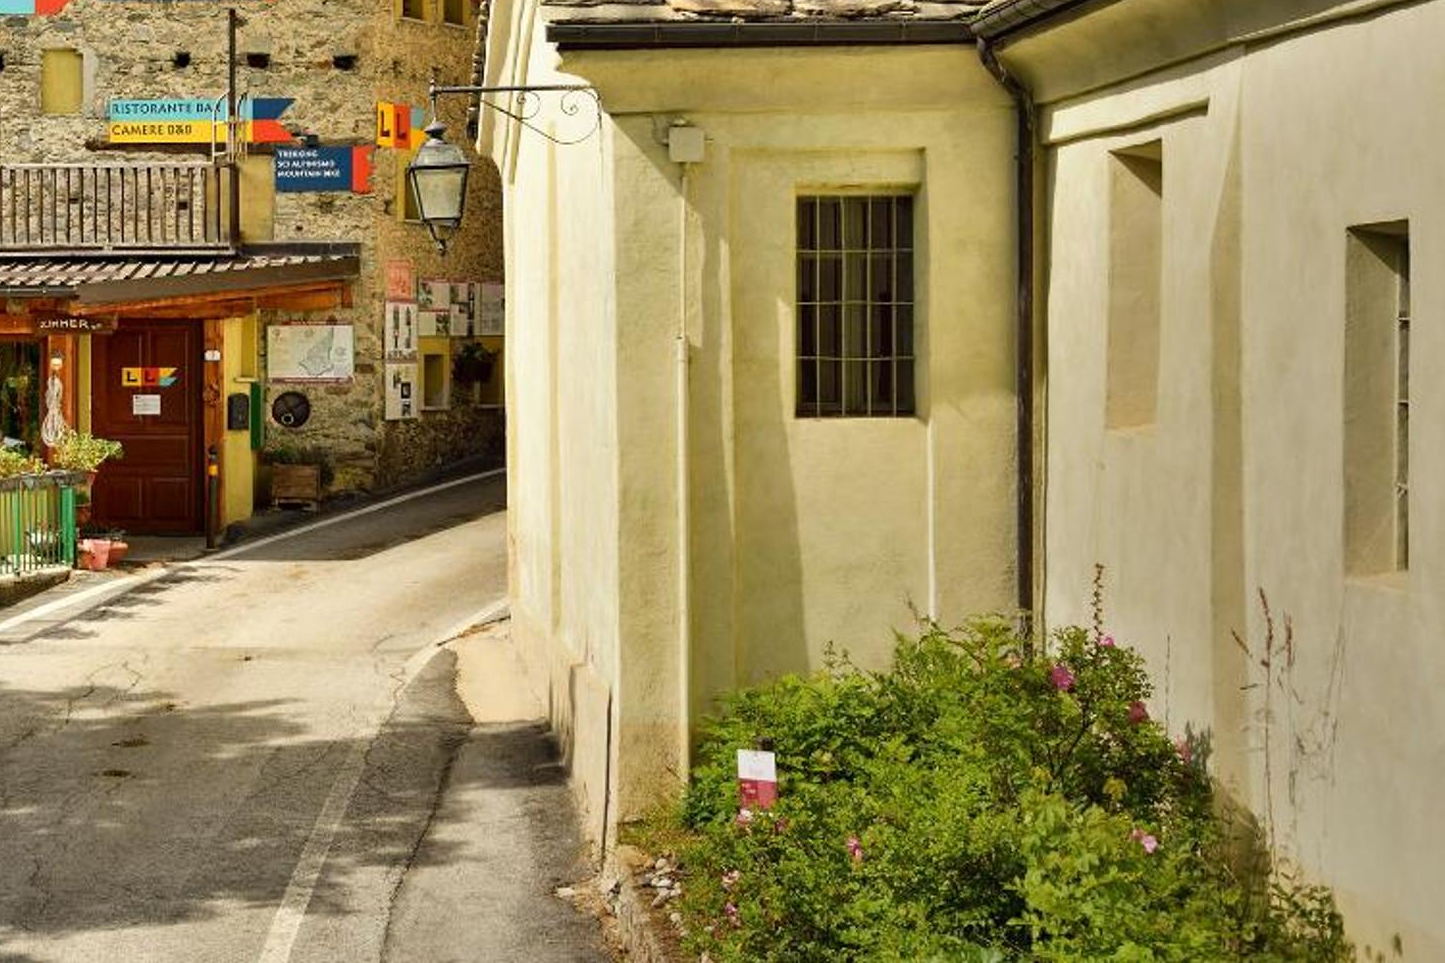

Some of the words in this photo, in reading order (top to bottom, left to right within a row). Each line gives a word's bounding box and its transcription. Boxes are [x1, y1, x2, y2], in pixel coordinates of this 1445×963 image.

[112, 103, 191, 114] RISTORANTE
[112, 124, 164, 135] CAMERE
[167, 124, 192, 135] B&B
